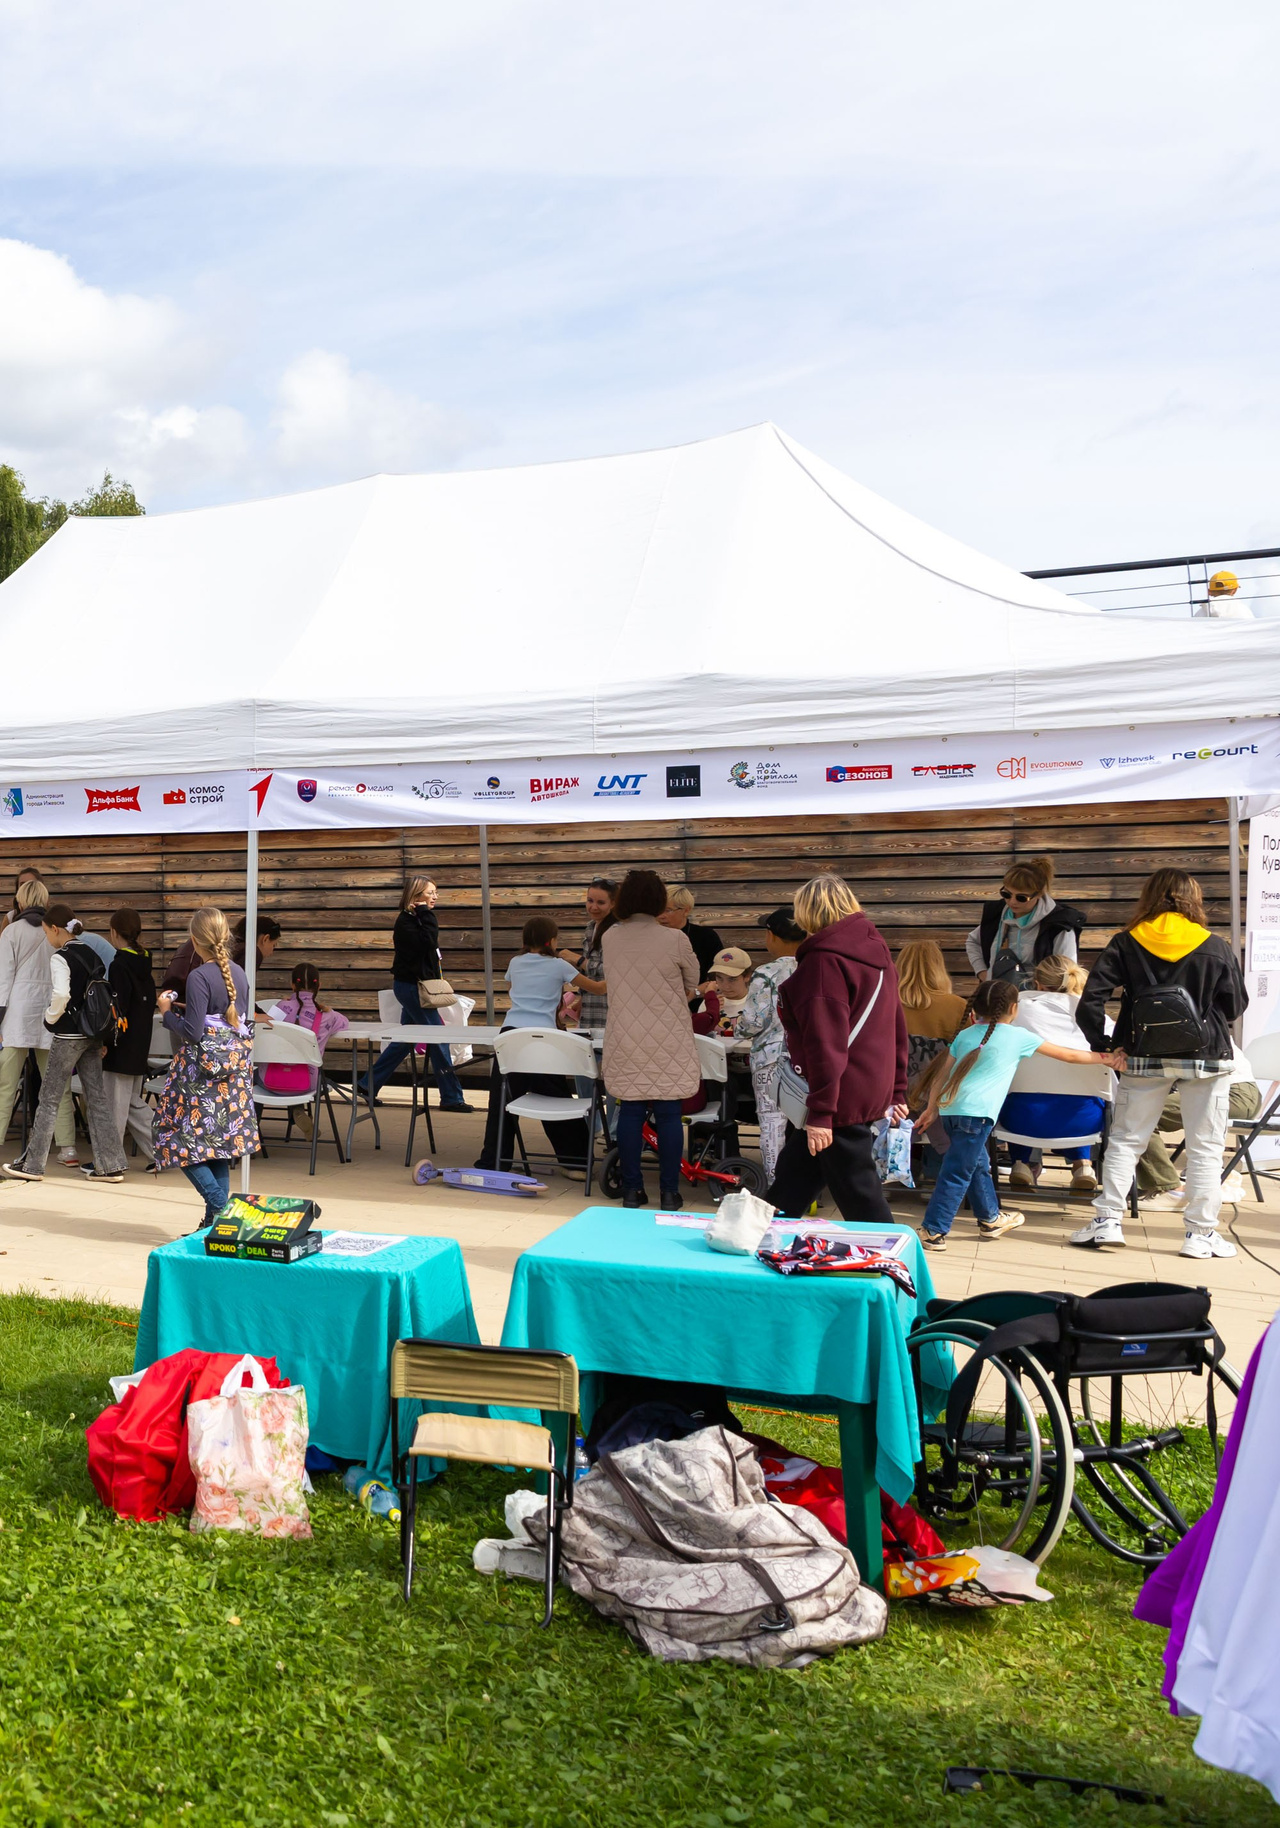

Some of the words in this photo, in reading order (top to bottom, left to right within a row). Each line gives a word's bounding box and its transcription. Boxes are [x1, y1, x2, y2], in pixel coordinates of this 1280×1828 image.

[1172, 744, 1258, 760] recourt
[1118, 755, 1154, 764] Izhevsk
[530, 777, 579, 794] ВИРАЖ
[598, 774, 647, 789] UNT
[92, 796, 115, 805] Альфа
[531, 790, 569, 802] АВТОШКОЛА
[209, 1243, 236, 1253] КРОКО
[247, 1246, 268, 1256] DEAL
